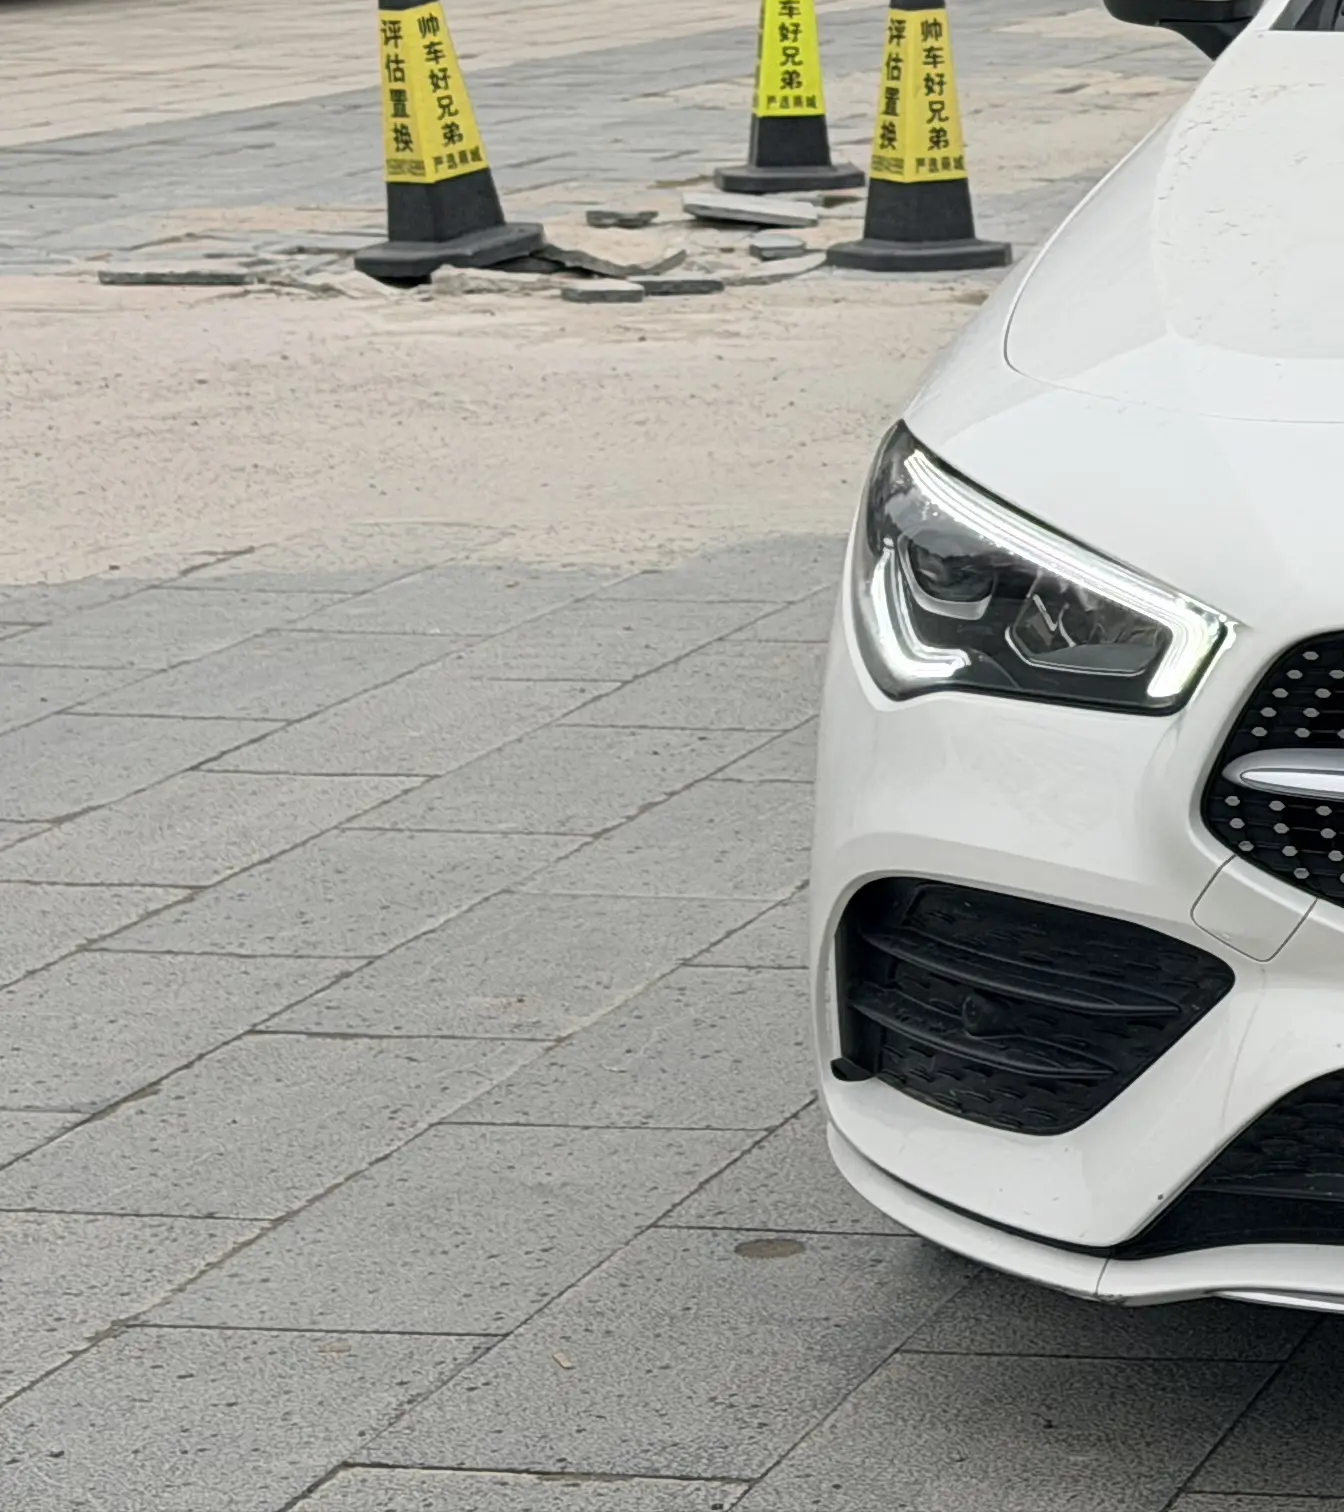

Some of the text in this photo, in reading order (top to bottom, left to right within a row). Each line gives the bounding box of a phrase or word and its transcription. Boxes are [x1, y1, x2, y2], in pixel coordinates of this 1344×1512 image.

[381, 19, 413, 153] 评估置换
[417, 12, 464, 147] 帅车好兄弟
[879, 17, 907, 151] 评估置换
[920, 17, 950, 151] 帅车好兄弟
